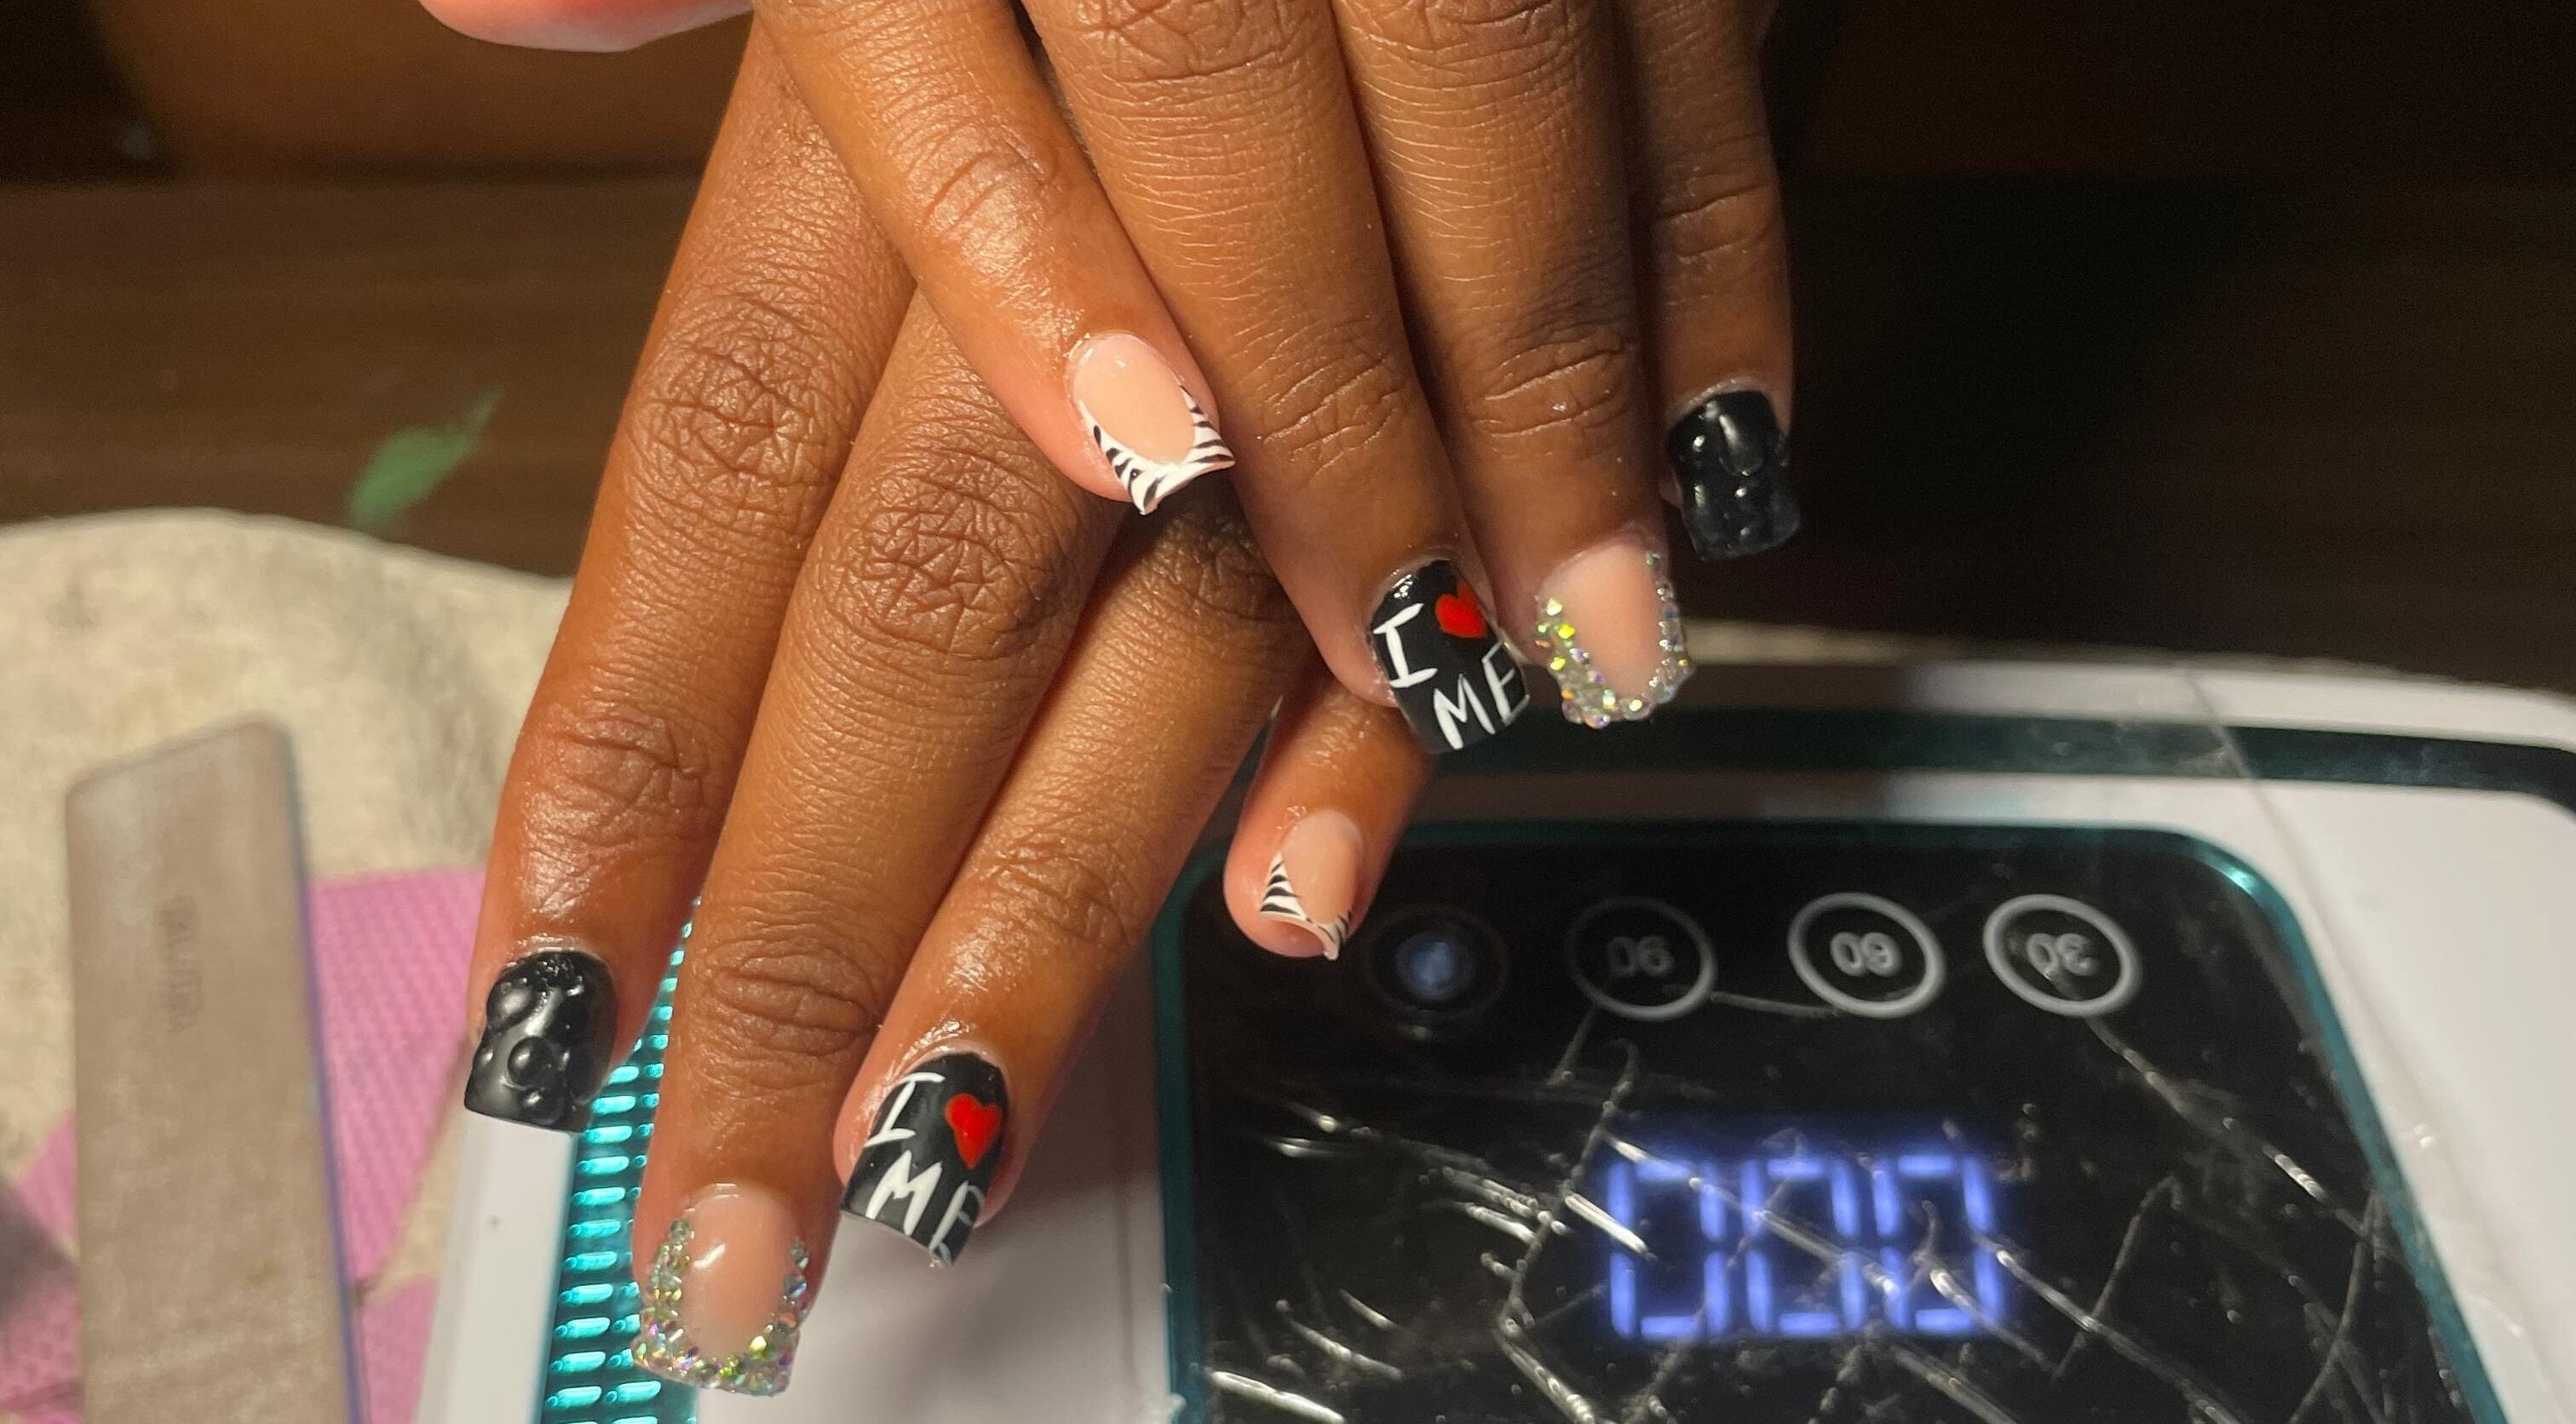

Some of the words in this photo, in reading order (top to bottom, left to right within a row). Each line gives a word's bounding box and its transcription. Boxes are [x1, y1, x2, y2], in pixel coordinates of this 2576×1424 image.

[1373, 602, 1439, 688] I
[1433, 639, 1531, 750] ME
[862, 1071, 946, 1148] I
[865, 1149, 986, 1266] ME
[1608, 1154, 2004, 1339] 000
